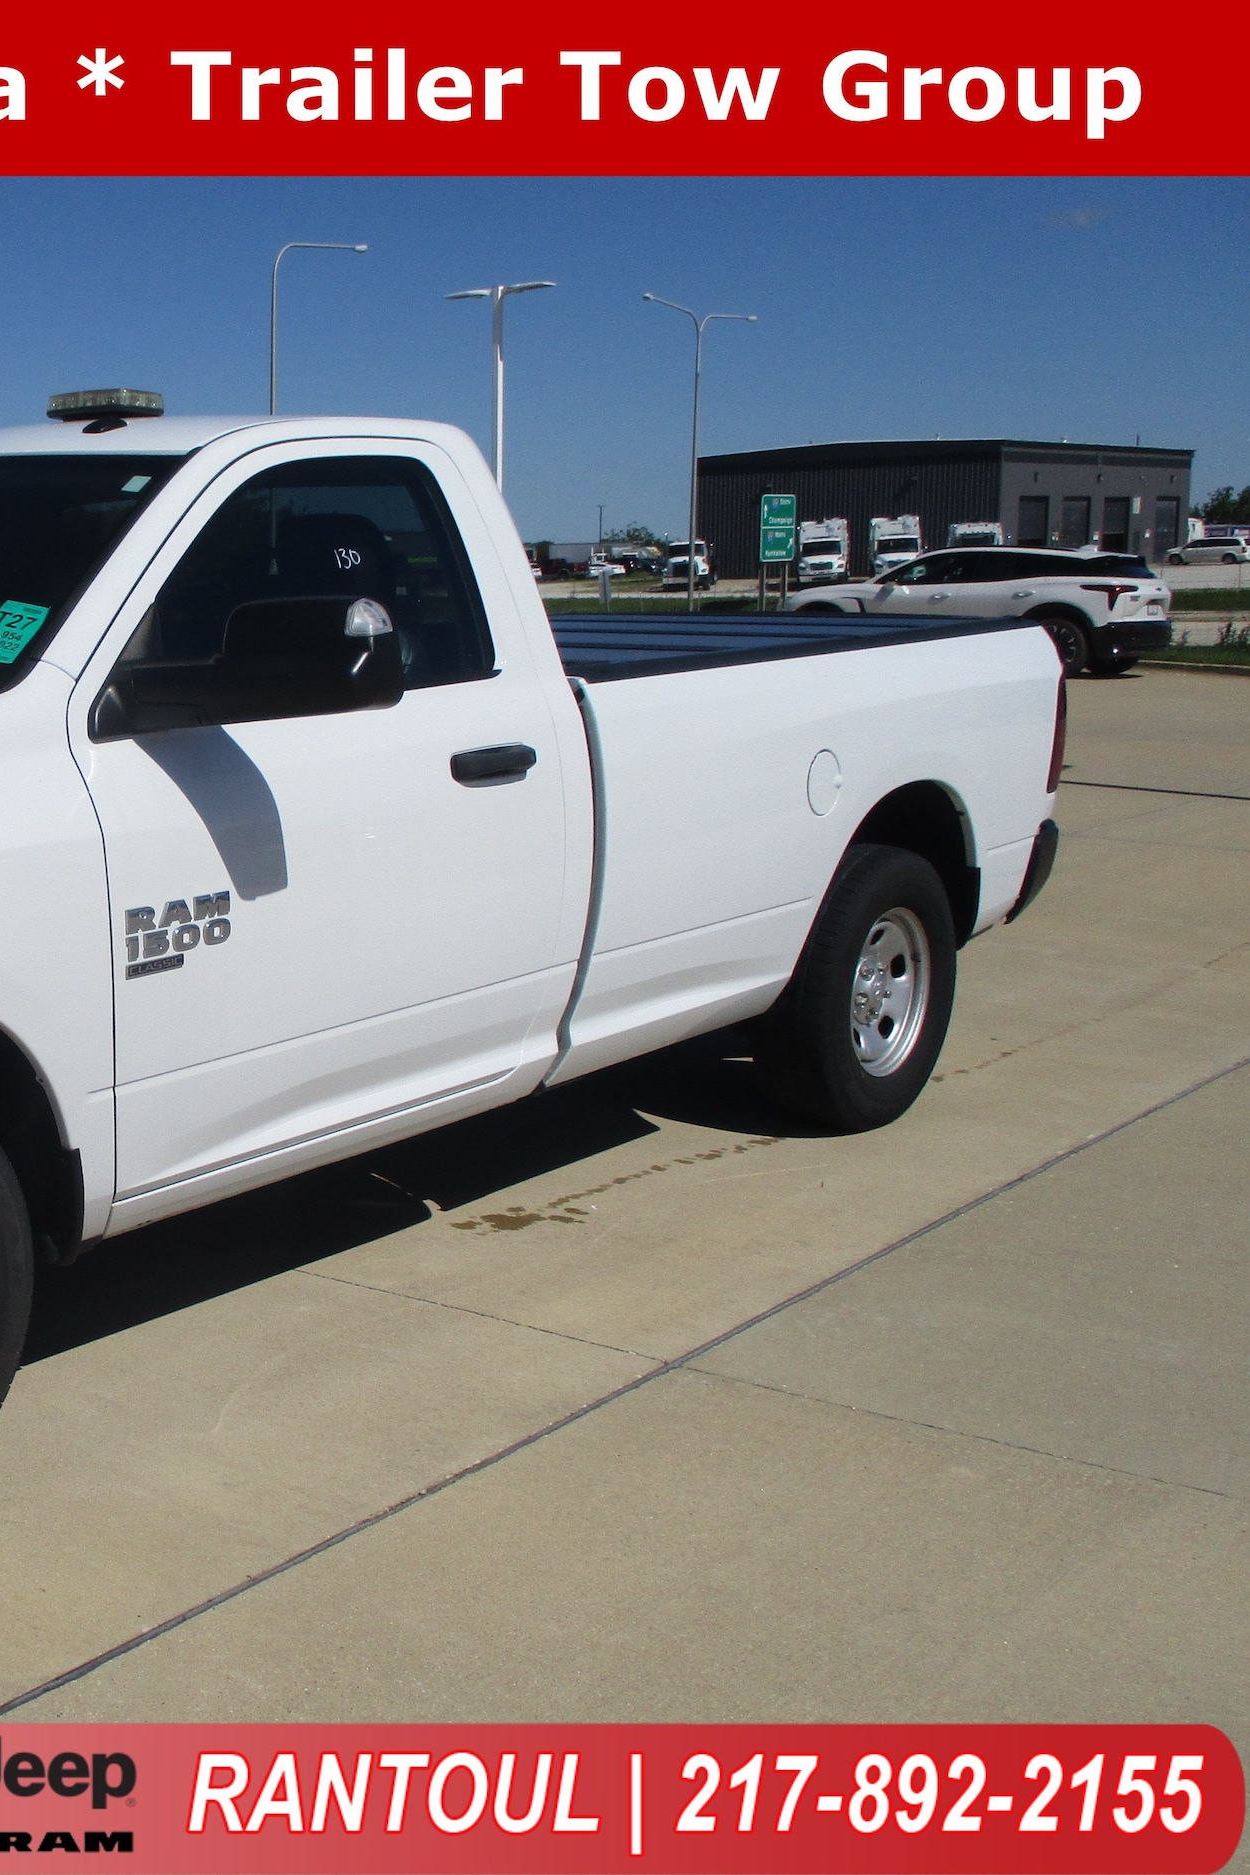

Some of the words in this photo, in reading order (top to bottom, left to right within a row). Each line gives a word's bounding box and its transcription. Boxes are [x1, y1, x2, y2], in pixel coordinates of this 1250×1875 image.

[333, 548, 361, 569] 130
[125, 890, 231, 936] RAM
[125, 917, 232, 963] 1500
[129, 957, 184, 976] CLASSIC
